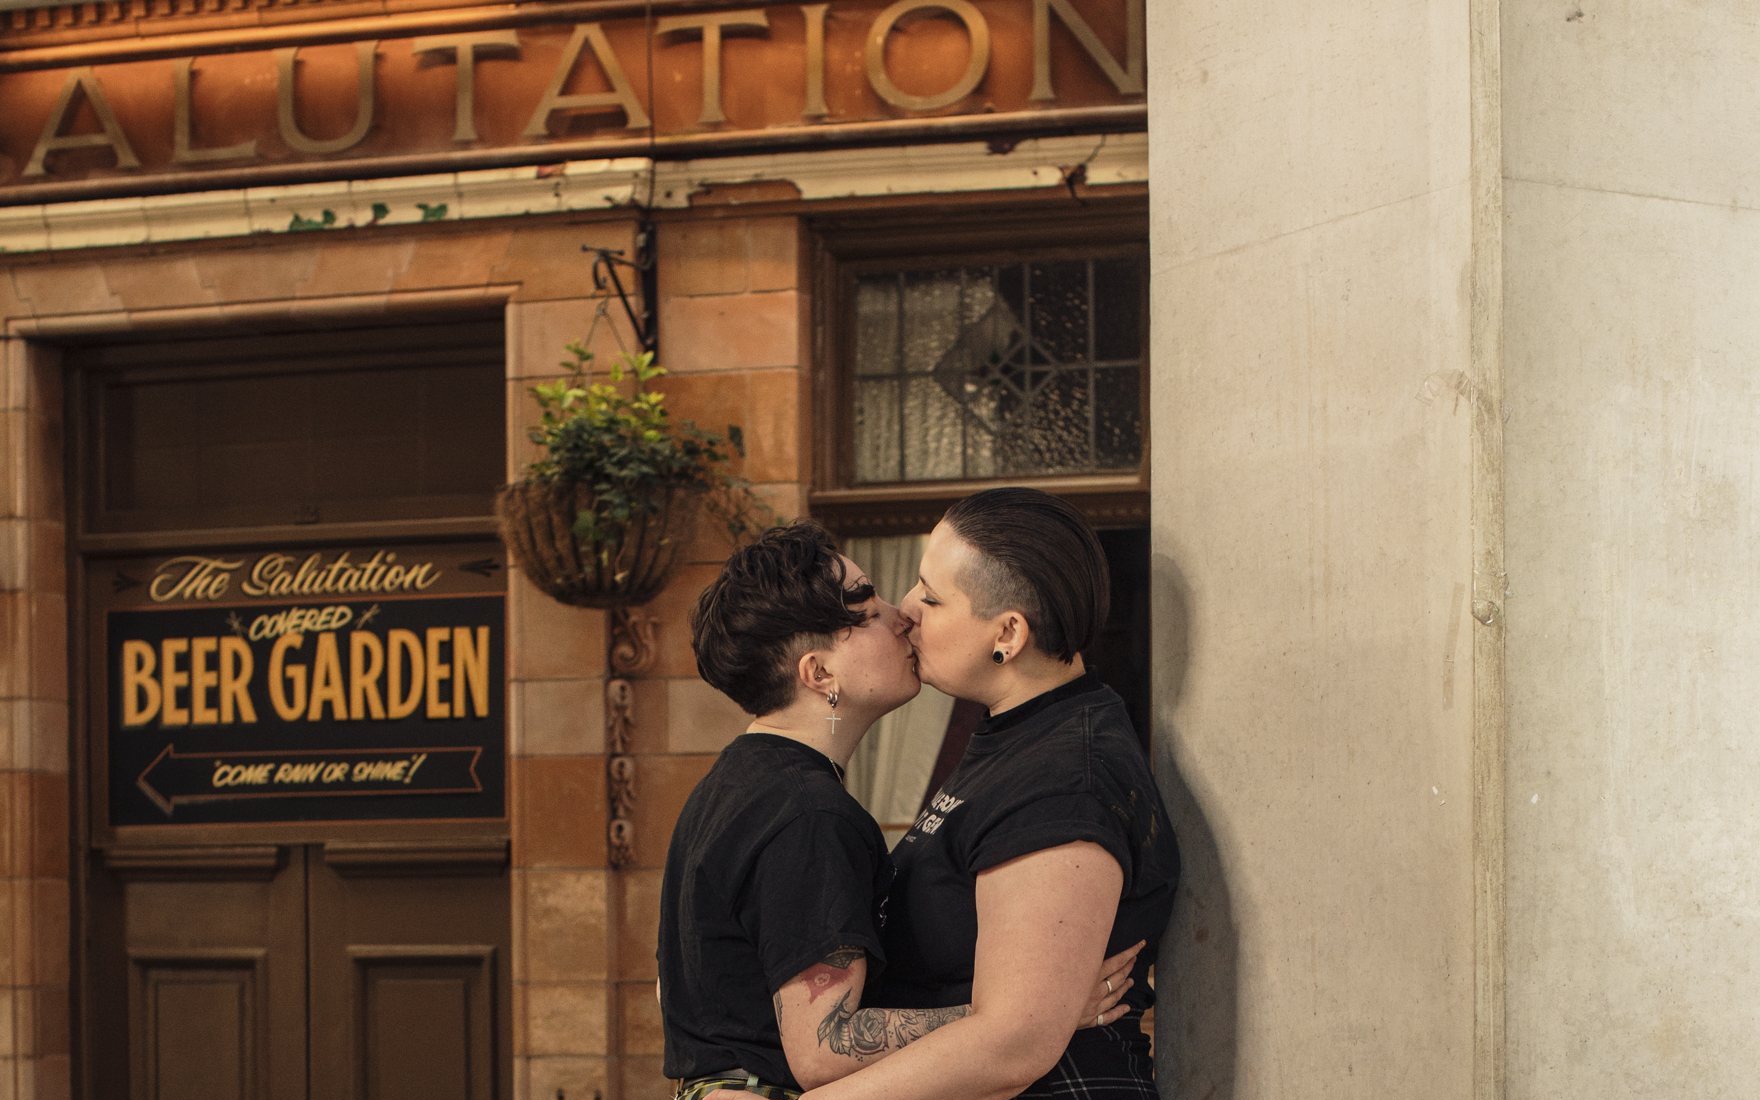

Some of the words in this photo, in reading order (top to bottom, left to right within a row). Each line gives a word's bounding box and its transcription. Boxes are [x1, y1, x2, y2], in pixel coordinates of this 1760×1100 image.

[22, 0, 1144, 176] ALUTATION
[149, 556, 244, 602] The
[242, 550, 442, 597] Salutation
[248, 606, 352, 641] COVERED
[123, 636, 257, 726] BEER
[268, 626, 490, 722] GARDEN
[273, 761, 326, 784] RAIN
[321, 762, 350, 784] OR
